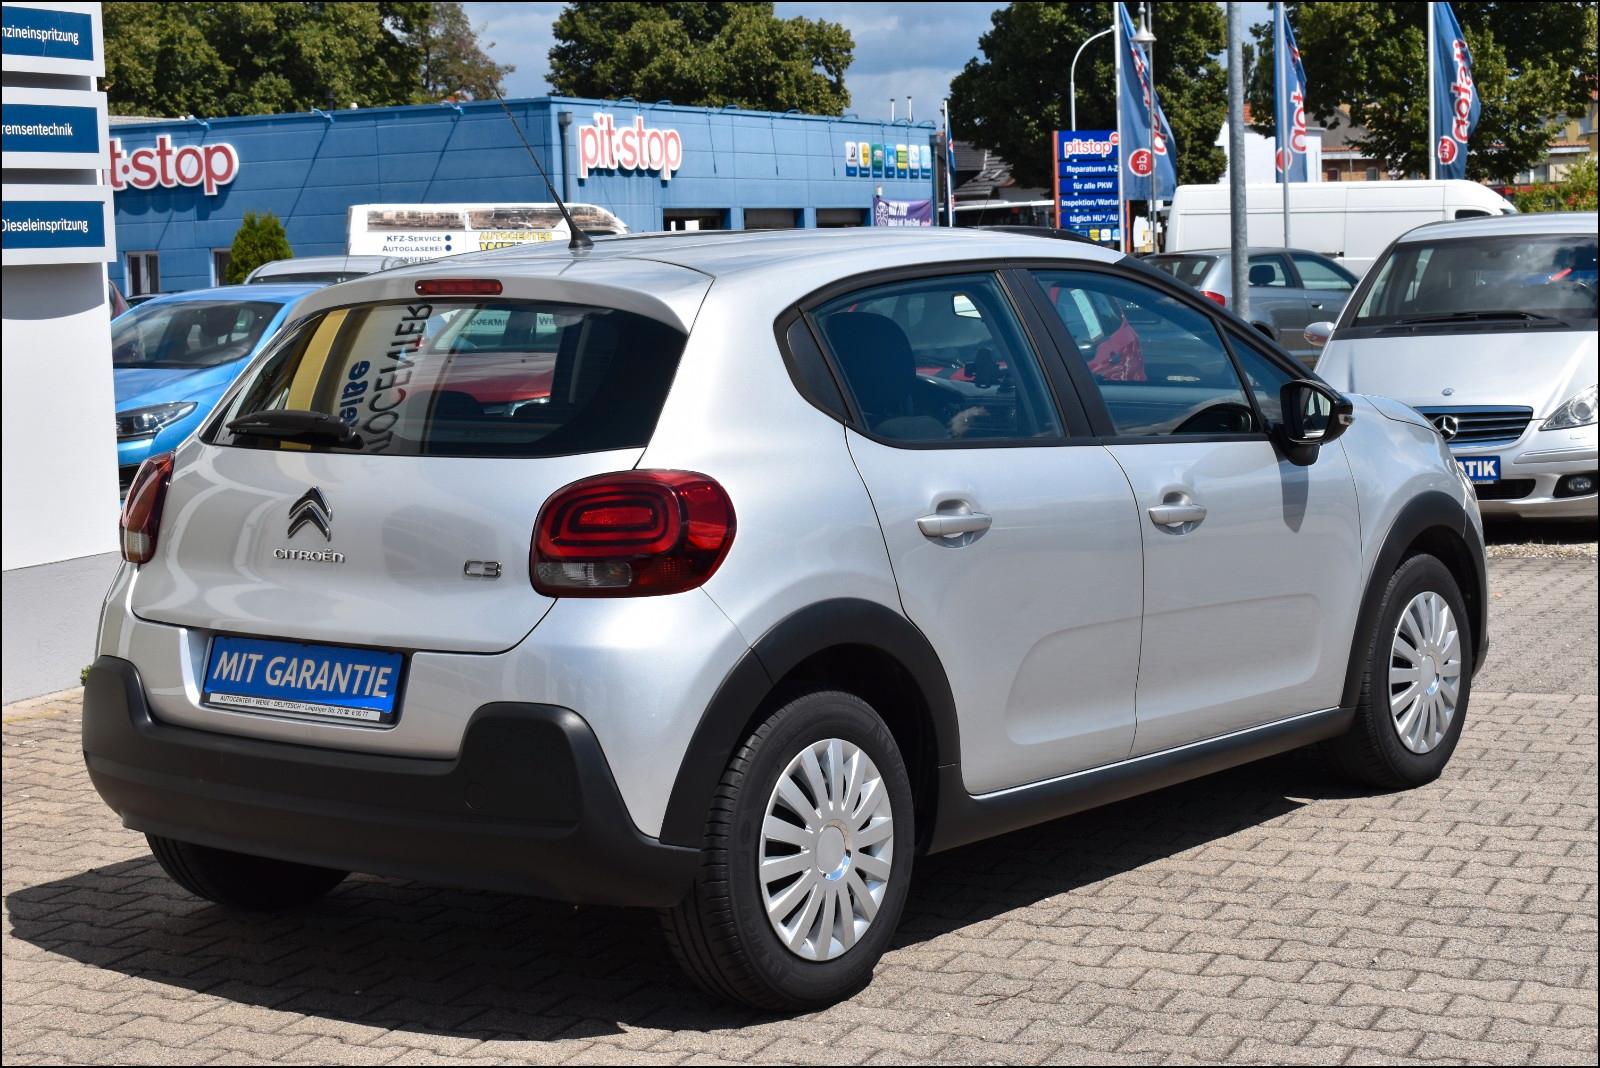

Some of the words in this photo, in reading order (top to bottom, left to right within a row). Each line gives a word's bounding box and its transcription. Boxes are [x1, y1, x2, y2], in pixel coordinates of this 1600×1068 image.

[1063, 138, 1112, 158] pitstop
[1066, 165, 1107, 173] Reparaturen
[1073, 182, 1083, 190] für
[1083, 182, 1096, 190] alle
[1069, 214, 1092, 224] täglich
[479, 231, 553, 241] AUTOCENTER
[463, 559, 502, 578] C3
[213, 651, 263, 683] MIT
[265, 656, 393, 698] GARANTIE
[220, 694, 252, 703] AUTOCENTER
